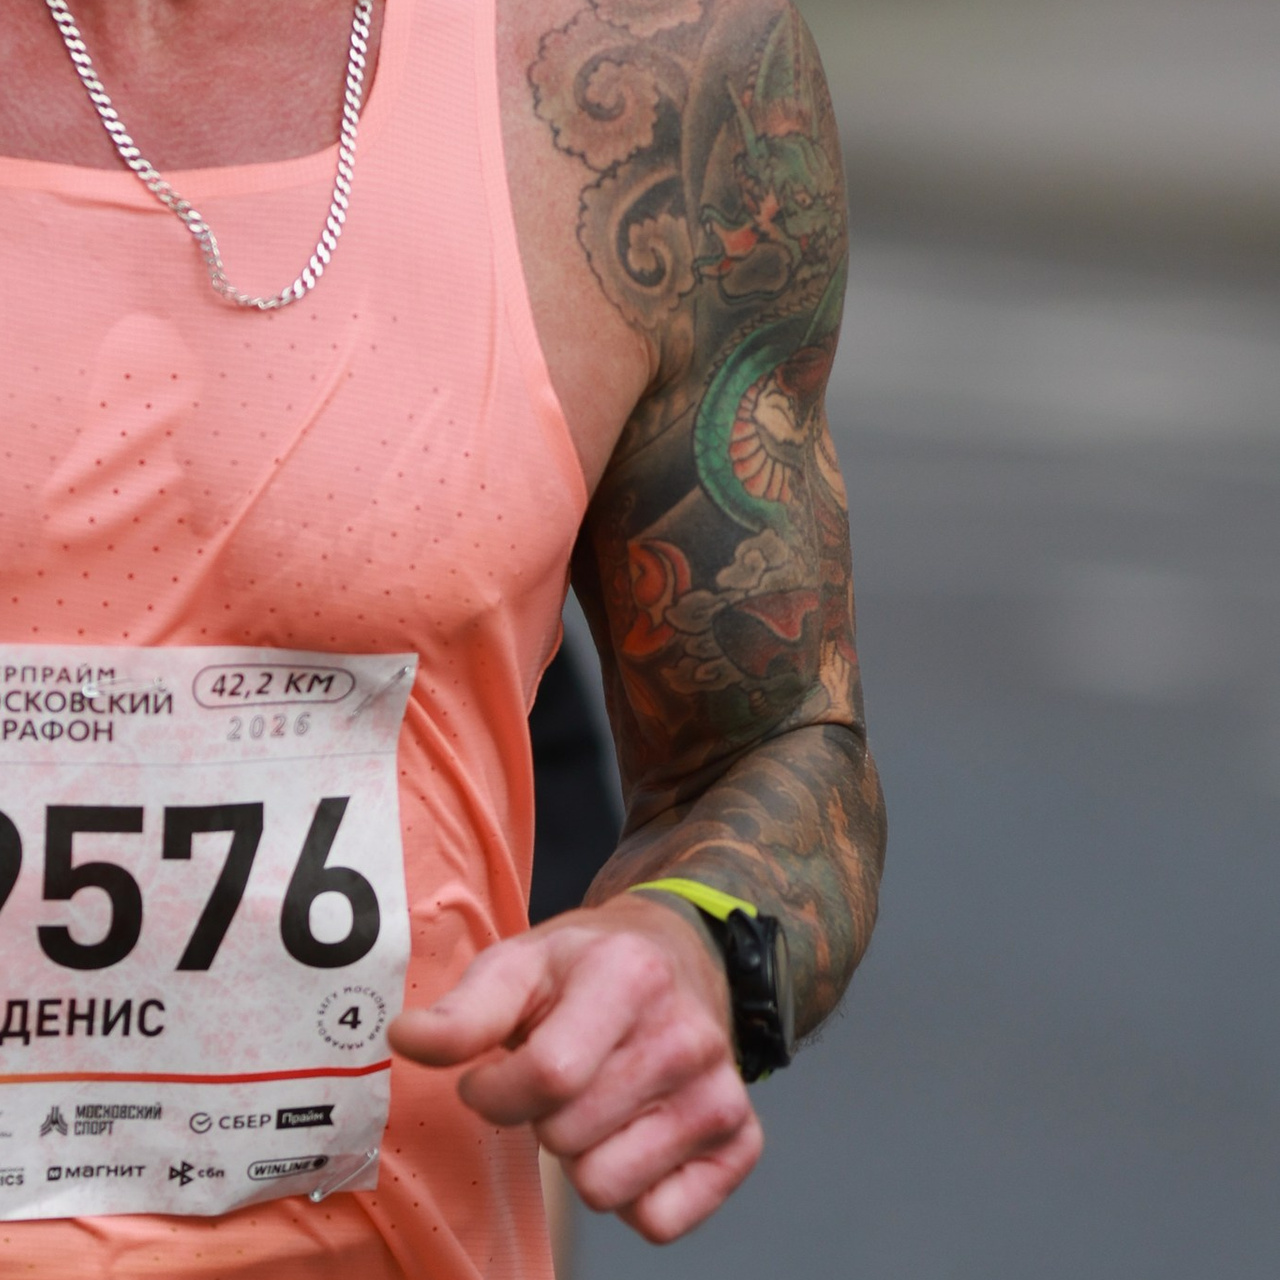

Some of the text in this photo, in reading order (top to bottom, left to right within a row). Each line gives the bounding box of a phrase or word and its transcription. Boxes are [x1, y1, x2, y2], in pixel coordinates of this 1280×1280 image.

[211, 672, 272, 699] 42,2
[226, 712, 311, 741] 2026
[338, 1006, 362, 1030] 4
[75, 1103, 162, 1120] МОСКОВСКИЙ
[218, 1111, 324, 1130] СБЕР Прайм
[74, 1120, 114, 1136] СПОРТ
[197, 1167, 225, 1178] сбп
